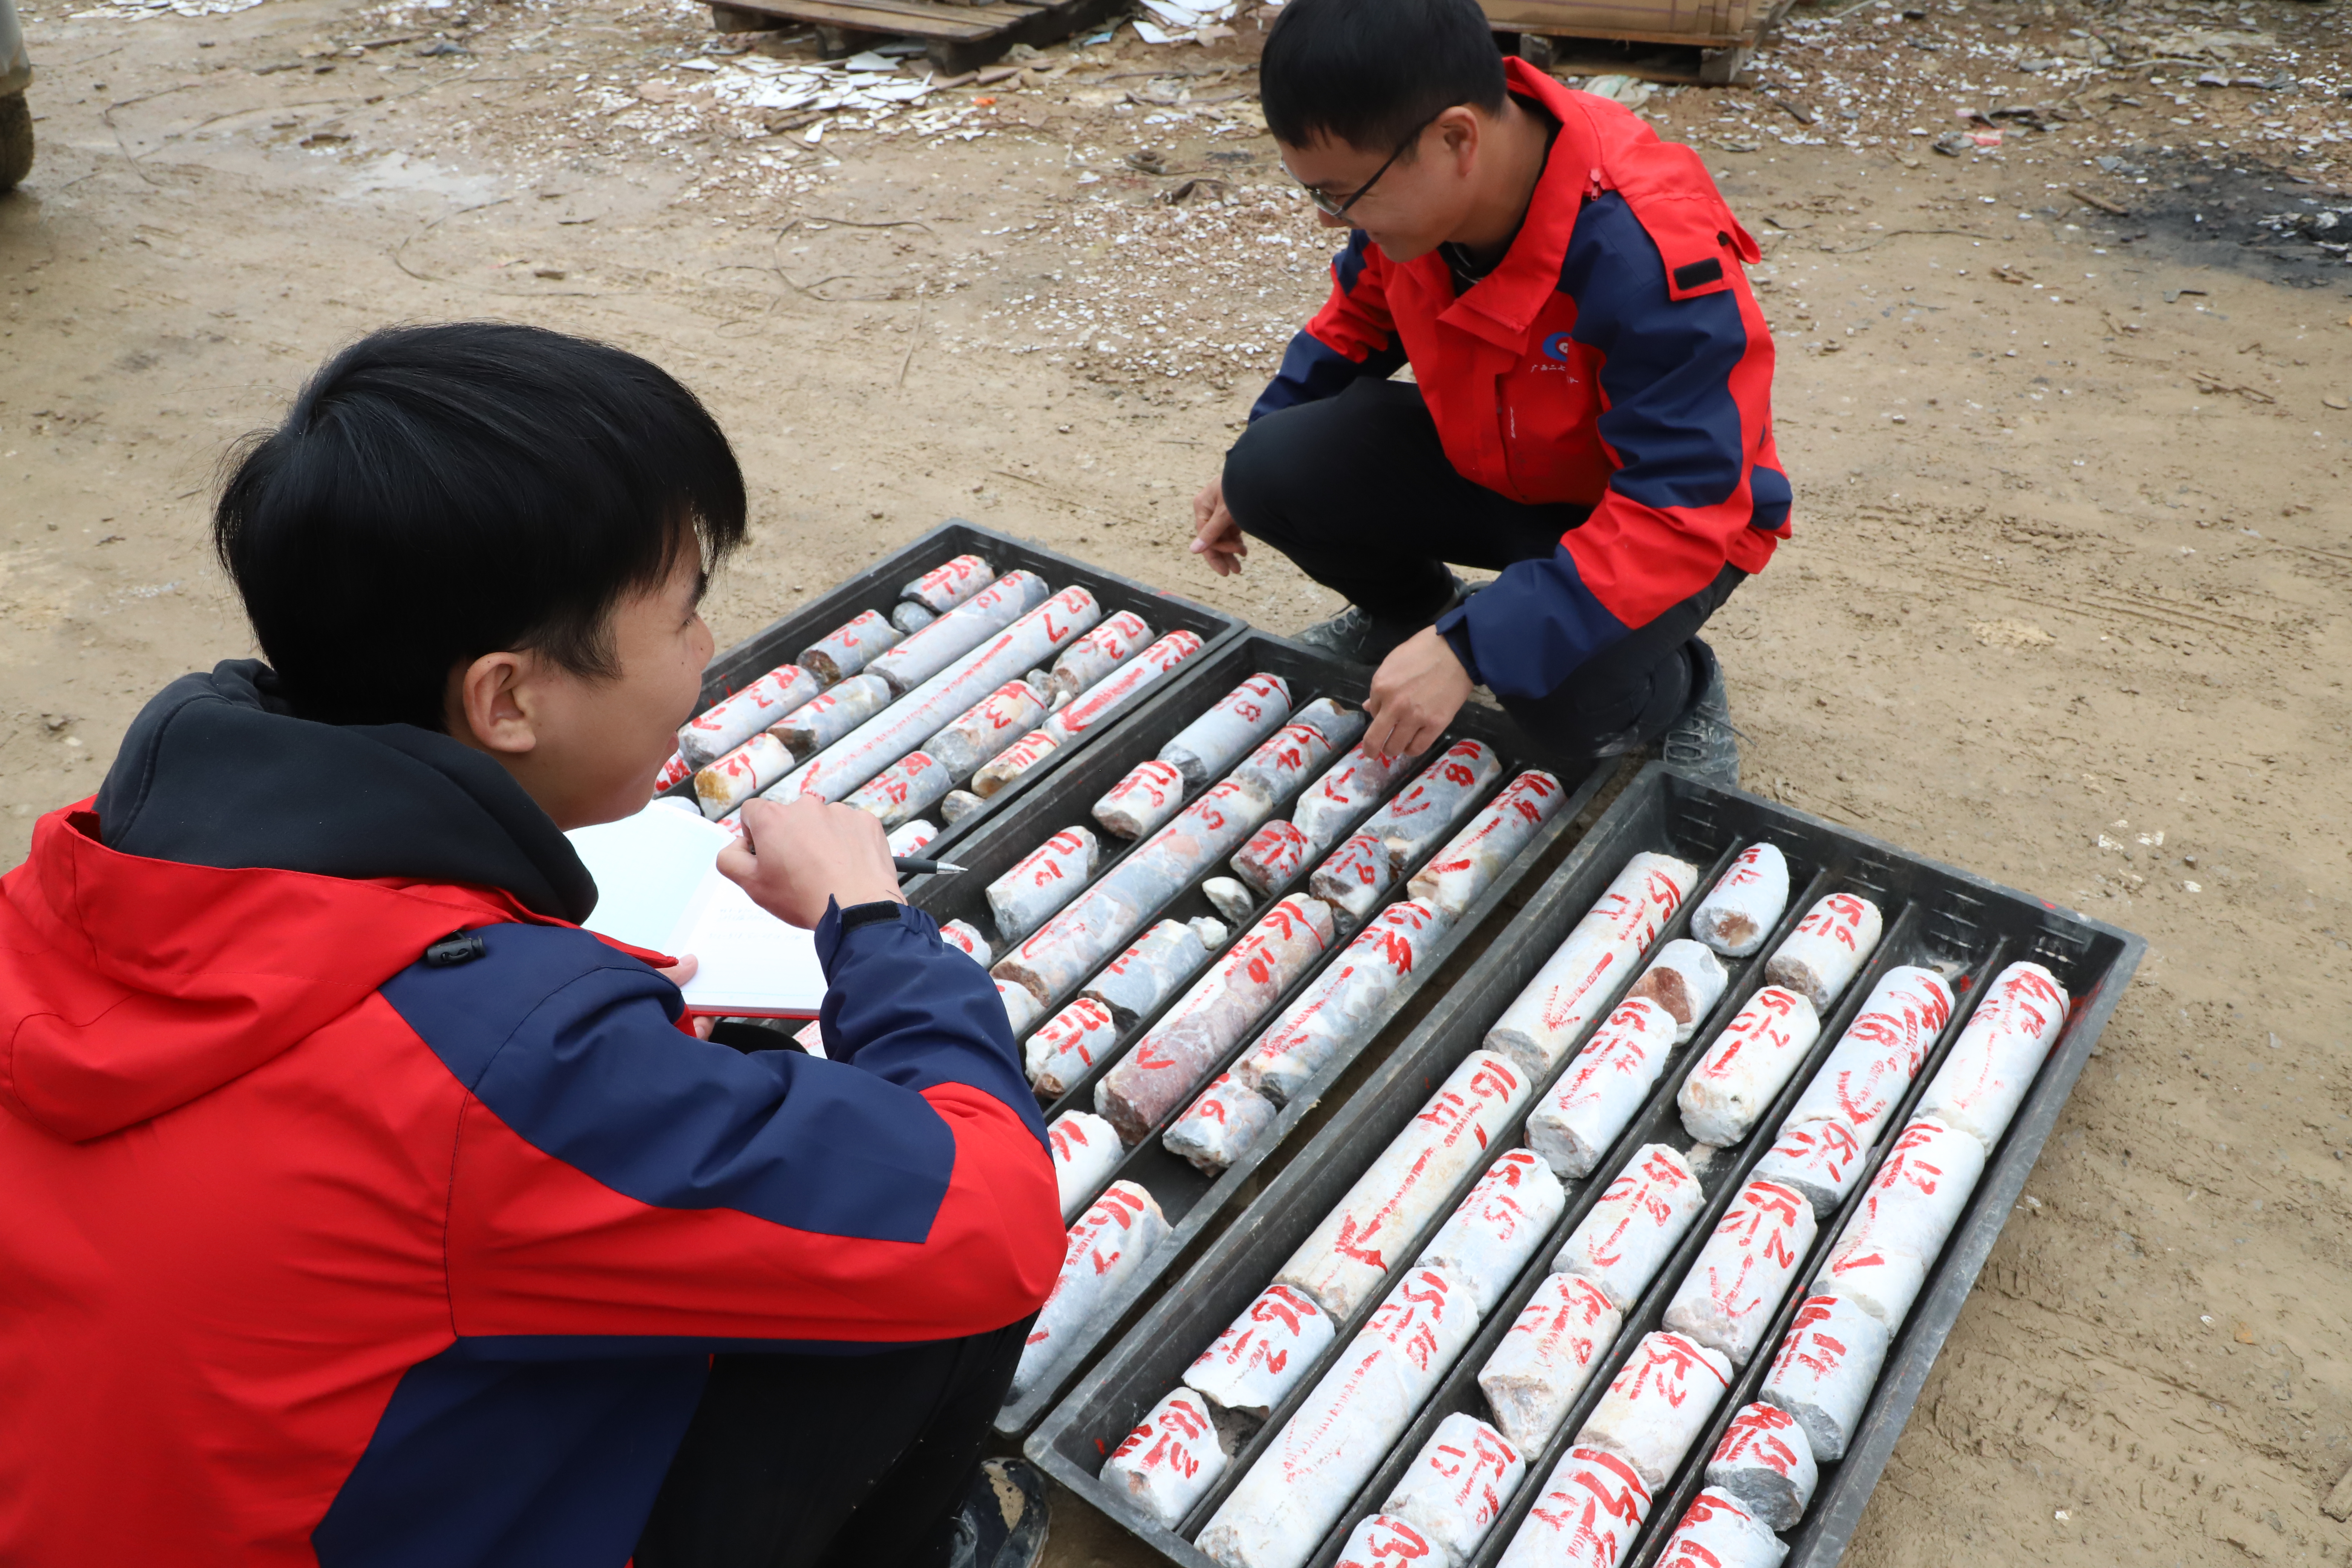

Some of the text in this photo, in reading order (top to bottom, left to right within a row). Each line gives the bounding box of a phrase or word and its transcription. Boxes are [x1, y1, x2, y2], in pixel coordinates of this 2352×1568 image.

[1044, 614, 1068, 643] 7
[1827, 895, 1864, 926] 15
[1760, 990, 1796, 1016] 15
[1471, 1060, 1517, 1102] 16
[1642, 1152, 1687, 1187] 15
[1744, 1181, 1801, 1227] 15
[1159, 1401, 1207, 1439] 16
